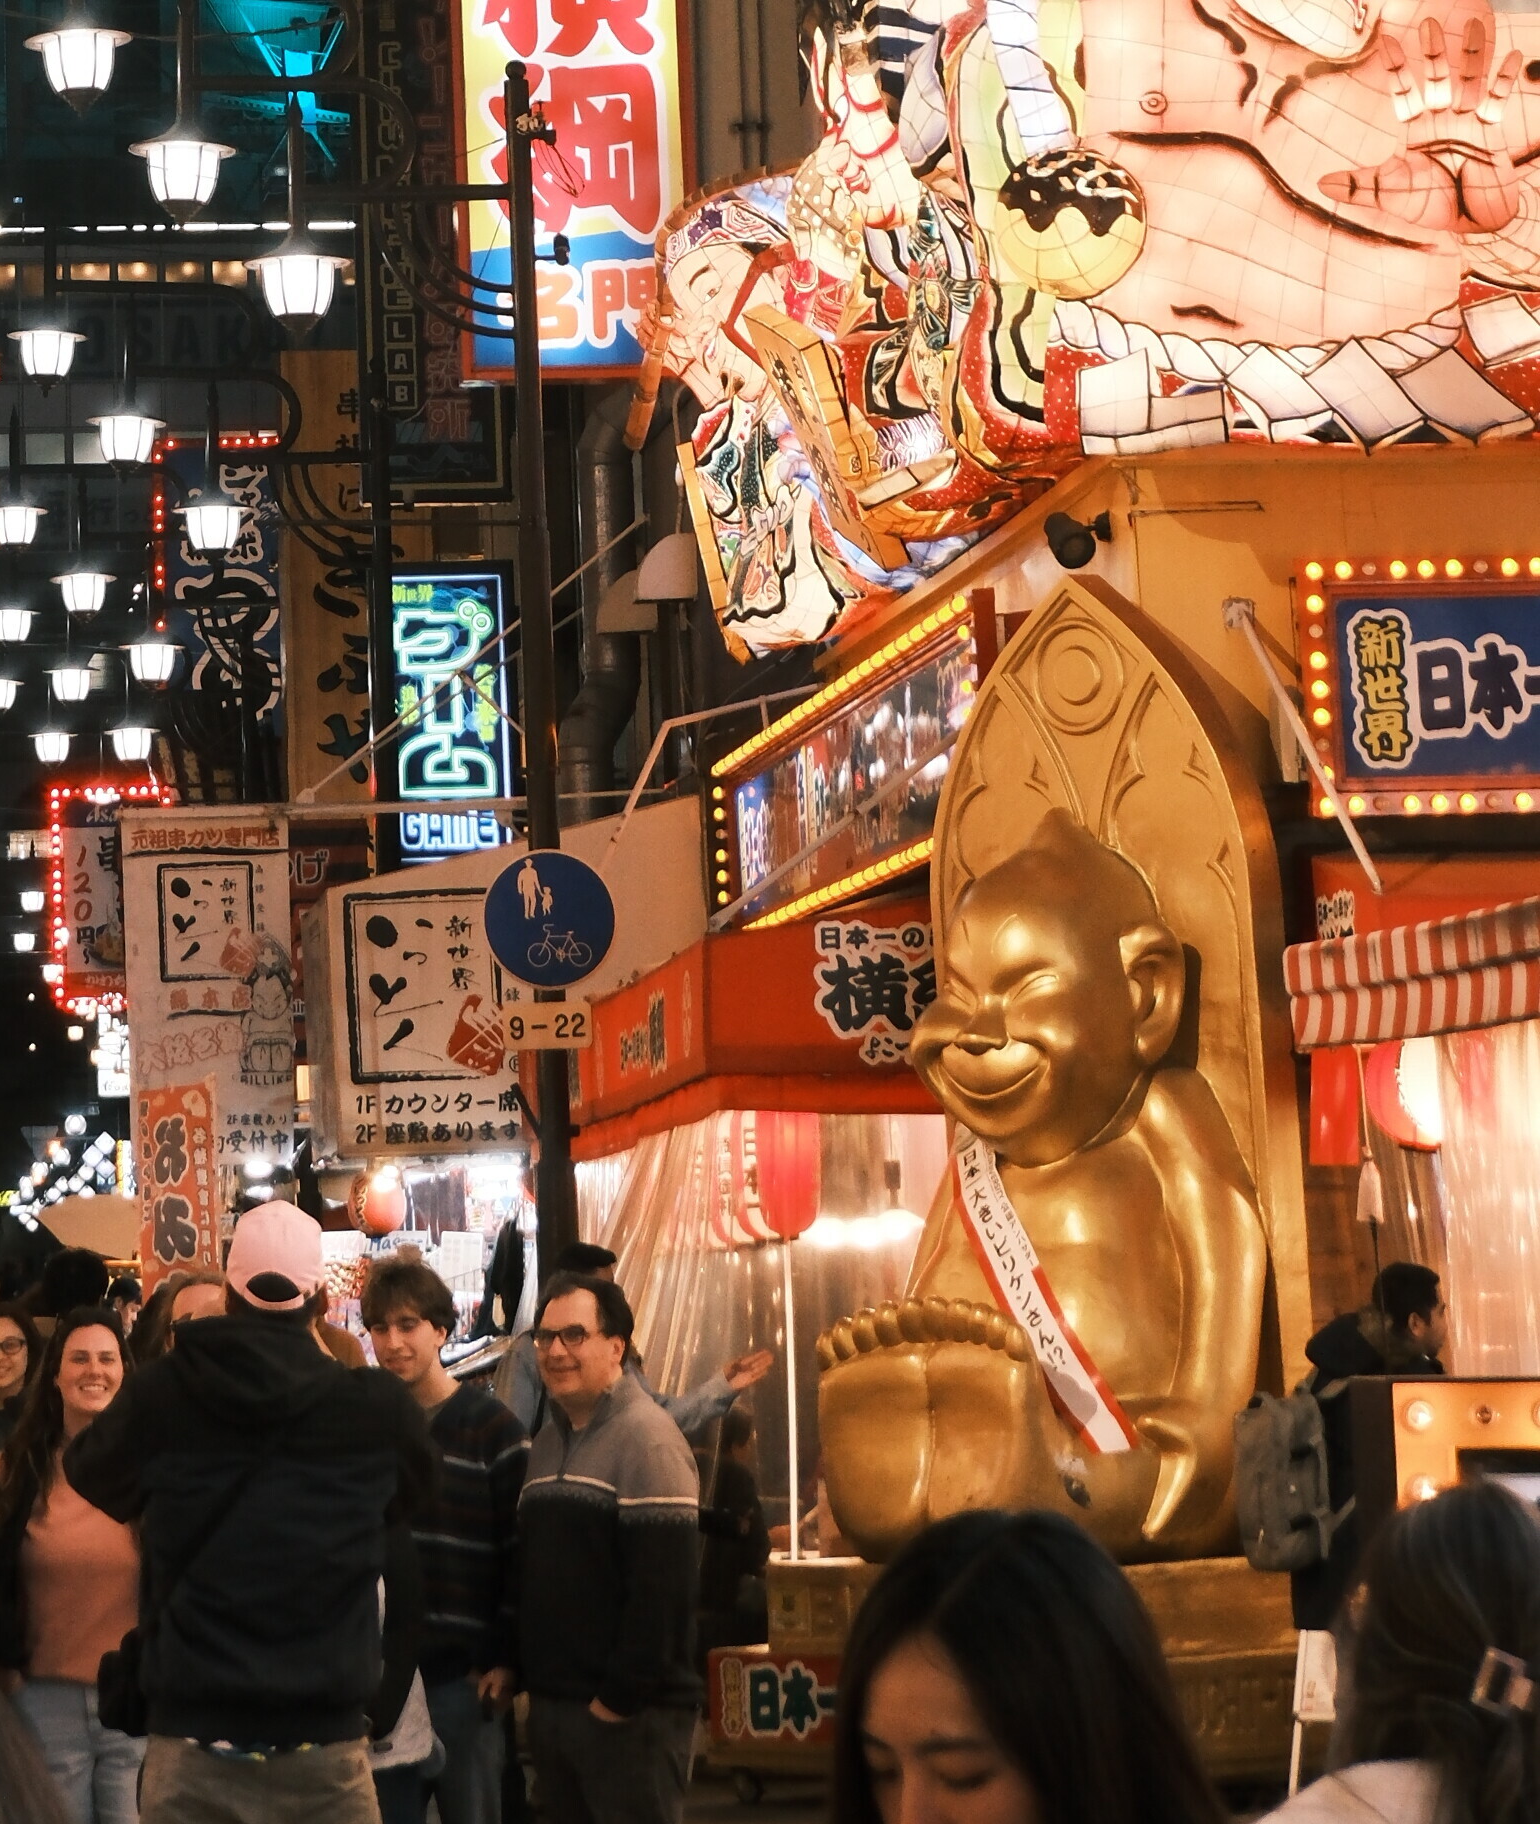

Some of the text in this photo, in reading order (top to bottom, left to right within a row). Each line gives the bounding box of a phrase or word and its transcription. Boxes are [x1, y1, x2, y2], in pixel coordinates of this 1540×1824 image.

[1356, 618, 1412, 760] 新世界
[131, 826, 280, 850] 元祖串カツ専門店
[821, 926, 933, 950] 日本一の
[445, 914, 479, 991] 新世界
[510, 1013, 586, 1040] 9-22
[355, 1095, 377, 1115] 1F
[355, 1121, 520, 1145] 2F 座敷あります
